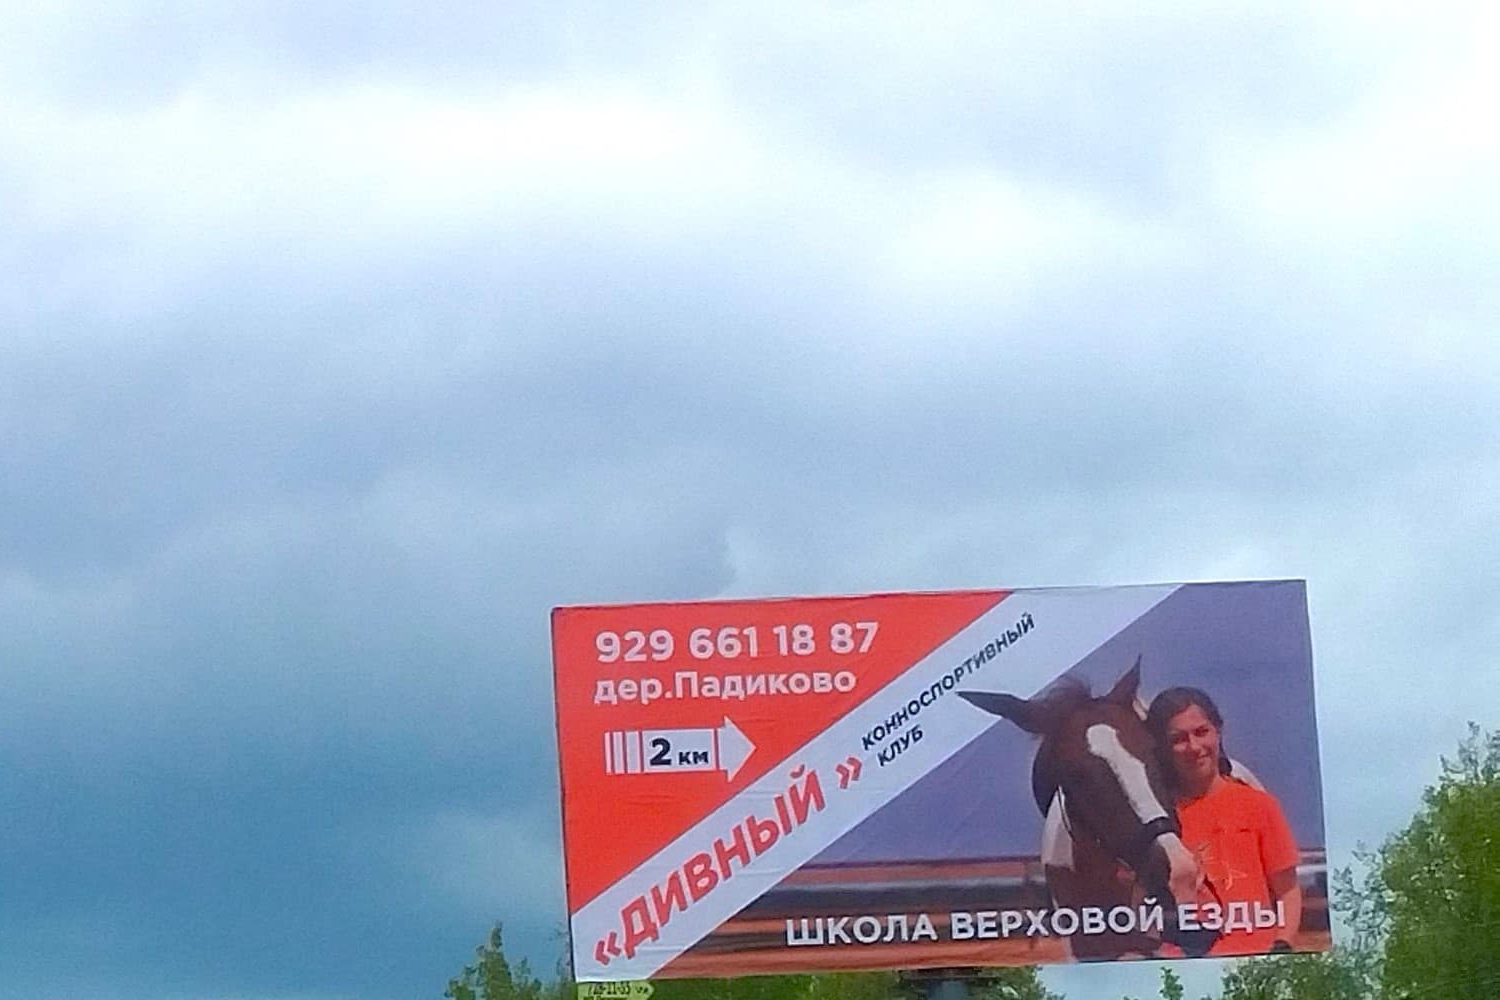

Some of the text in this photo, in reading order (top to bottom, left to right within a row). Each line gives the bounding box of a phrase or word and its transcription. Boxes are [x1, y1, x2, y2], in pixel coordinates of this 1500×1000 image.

[595, 622, 879, 663] 929 661 18 87
[861, 612, 1036, 751] КОННОСПОРТИВНЫЙ
[649, 738, 672, 766] 2
[877, 724, 924, 767] КЛУБ
[786, 897, 1286, 946] ШКОЛА ВЕРХОВОЙ ЕЗДЫ
